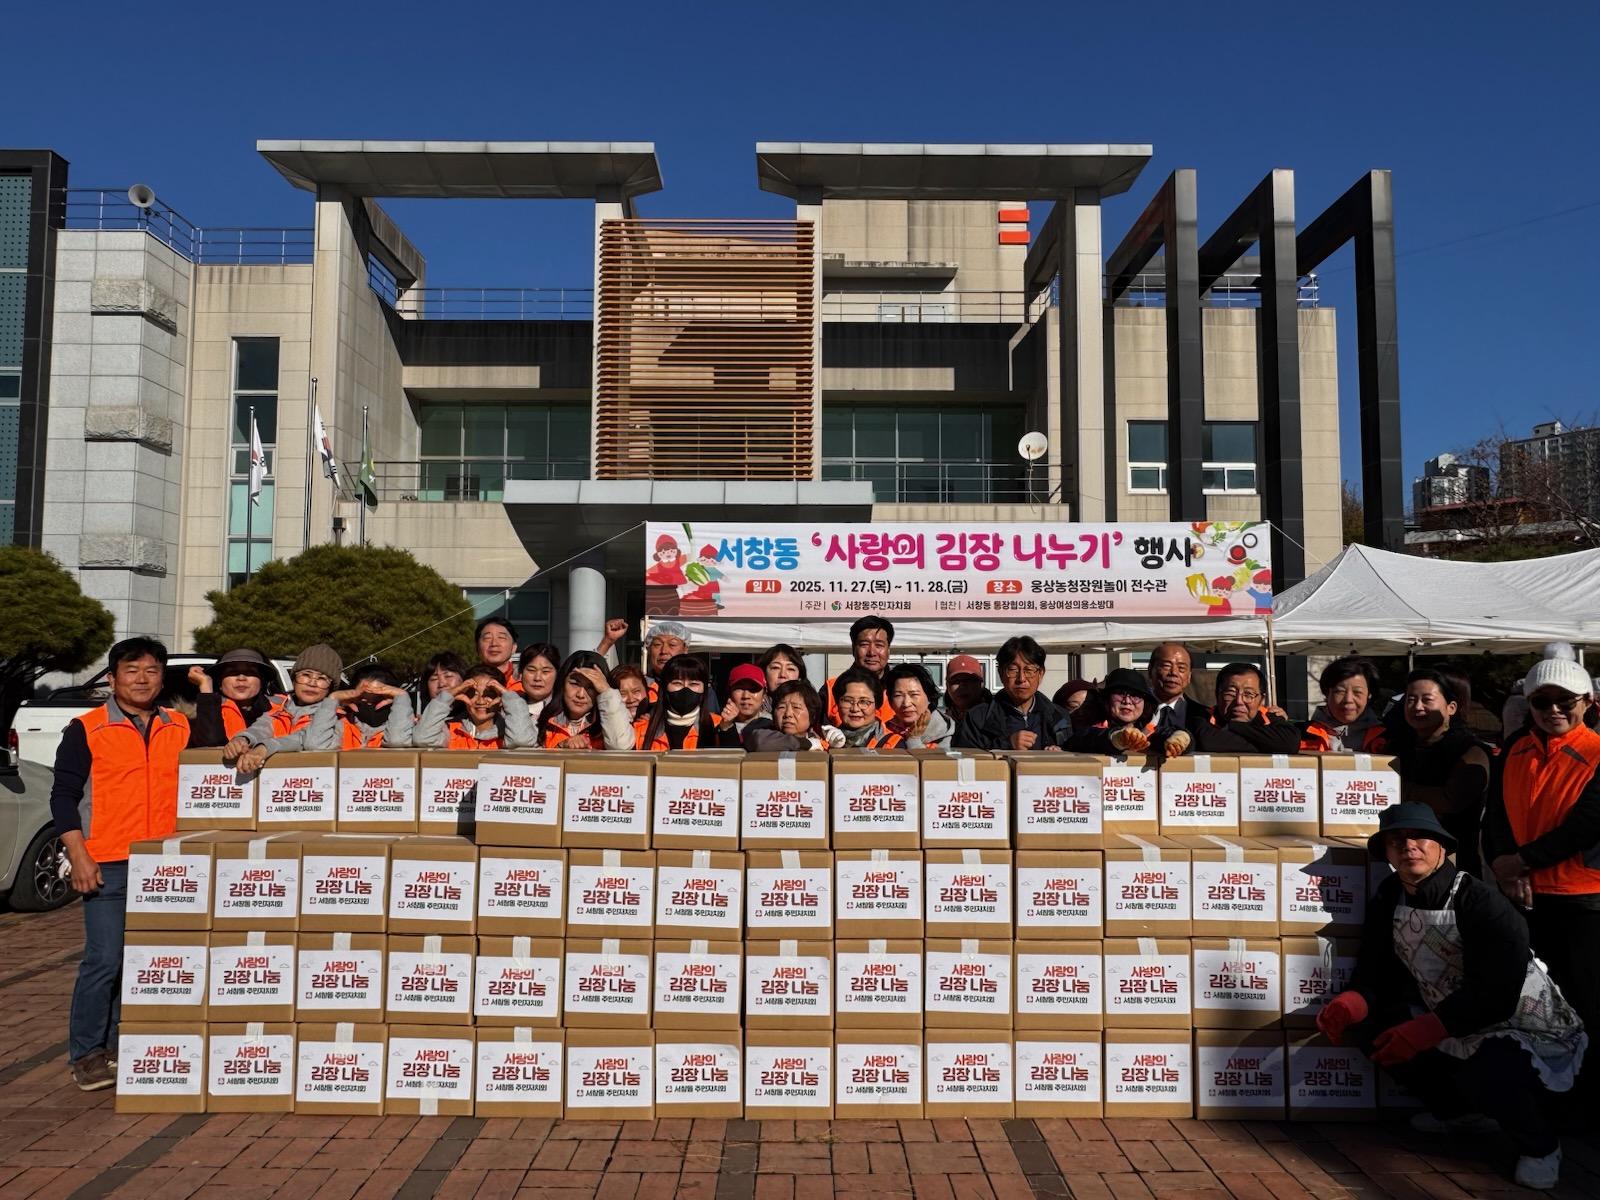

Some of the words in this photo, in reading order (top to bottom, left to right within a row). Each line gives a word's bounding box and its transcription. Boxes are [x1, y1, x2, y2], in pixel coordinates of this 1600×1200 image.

[716, 537, 800, 570] 서창동
[936, 532, 1004, 571] 김장
[1134, 536, 1191, 570] 행사
[993, 581, 1017, 592] 장소
[1031, 579, 1127, 593] 웅상농청장원놀이
[1131, 579, 1167, 593] 전수관
[845, 601, 911, 610] 서창동주민자치회
[966, 601, 991, 610] 서창동
[1039, 601, 1114, 610] 웅상여성의용소방대
[282, 778, 312, 788] 사랑의
[362, 778, 393, 788] 사랑의
[502, 776, 535, 788] 사랑의
[1185, 783, 1215, 793] 사랑의
[1264, 779, 1294, 788] 사랑의
[272, 790, 297, 802] 김장
[299, 790, 323, 802] 나눔
[352, 790, 378, 802] 김장
[380, 790, 404, 802] 나눔
[490, 788, 517, 802] 김장
[520, 790, 546, 804] 나눔
[590, 786, 622, 797] 사랑의
[681, 789, 713, 800] 사랑의
[767, 791, 800, 802] 사랑의
[860, 785, 894, 796] 사랑의
[1044, 787, 1077, 798] 사랑의
[1254, 790, 1279, 802] 김장
[1282, 791, 1306, 803] 나눔
[578, 798, 605, 812] 김장
[608, 800, 634, 813] 나눔
[849, 798, 877, 811] 김장
[879, 798, 906, 811] 나눔
[1033, 800, 1061, 813] 김장
[1063, 800, 1090, 813] 나눔
[1174, 795, 1200, 807] 김장
[1202, 795, 1227, 807] 나눔
[669, 801, 696, 815] 김장
[699, 802, 725, 816] 나눔
[756, 804, 784, 817] 김장
[786, 805, 813, 818] 나눔
[154, 866, 186, 877] 사랑의
[241, 870, 274, 881] 사랑의
[327, 868, 360, 878] 사랑의
[416, 872, 450, 883] 사랑의
[506, 870, 539, 881] 사랑의
[595, 878, 628, 889] 사랑의
[951, 875, 985, 886] 사랑의
[1044, 879, 1077, 890] 사랑의
[1132, 873, 1166, 884] 사랑의
[1219, 873, 1253, 885] 사랑의
[142, 879, 169, 892] 김장
[172, 879, 198, 892] 나눔
[230, 884, 257, 896] 김장
[260, 884, 285, 897] 나눔
[316, 880, 343, 893] 김장
[346, 881, 372, 894] 나눔
[494, 883, 522, 896] 김장
[524, 884, 550, 897] 나눔
[684, 879, 716, 891] 사랑의
[772, 880, 806, 891] 사랑의
[404, 885, 432, 898] 김장
[435, 886, 461, 899] 나눔
[583, 890, 610, 904] 김장
[614, 892, 640, 905] 나눔
[940, 888, 968, 901] 김장
[971, 889, 997, 902] 나눔
[1121, 886, 1149, 899] 김장
[1152, 886, 1178, 899] 나눔
[1208, 886, 1236, 900] 김장
[1238, 887, 1265, 900] 나눔
[672, 892, 699, 905] 김장
[702, 893, 728, 907] 나눔
[761, 893, 789, 906] 김장
[791, 893, 818, 906] 나눔
[1032, 892, 1060, 905] 김장
[1063, 893, 1090, 906] 나눔
[149, 957, 182, 968] 사랑의
[235, 957, 268, 968] 사랑의
[682, 965, 715, 976] 사랑의
[773, 968, 806, 978] 사랑의
[951, 964, 985, 976] 사랑의
[1043, 966, 1077, 977] 사랑의
[138, 970, 165, 983] 김장
[168, 971, 194, 984] 나눔
[224, 970, 251, 984] 김장
[254, 970, 280, 984] 나눔
[670, 978, 698, 991] 김장
[700, 979, 727, 992] 나눔
[761, 981, 789, 994] 김장
[792, 981, 819, 994] 나눔
[940, 977, 968, 991] 김장
[970, 978, 997, 992] 나눔
[1032, 979, 1060, 992] 김장
[1063, 980, 1090, 993] 나눔
[145, 1046, 178, 1057] 사랑의
[415, 1050, 448, 1062] 사랑의
[594, 1059, 628, 1070] 사랑의
[682, 1055, 716, 1066] 사랑의
[772, 1058, 806, 1069] 사랑의
[954, 1054, 987, 1066] 사랑의
[1042, 1054, 1076, 1065] 사랑의
[1133, 1055, 1166, 1066] 사랑의
[133, 1060, 161, 1073] 김장
[164, 1060, 190, 1073] 나눔
[403, 1063, 431, 1077] 김장
[434, 1064, 460, 1078] 나눔
[582, 1072, 611, 1086] 김장
[613, 1072, 640, 1086] 나눔
[671, 1068, 699, 1082] 김장
[702, 1068, 728, 1082] 나눔
[761, 1072, 789, 1085] 김장
[792, 1072, 818, 1085] 나눔
[942, 1068, 971, 1081] 김장
[973, 1068, 1000, 1081] 나눔
[1031, 1067, 1059, 1080] 김장
[1062, 1067, 1088, 1080] 나눔
[1121, 1068, 1150, 1081] 김장
[1152, 1068, 1179, 1082] 나눔
